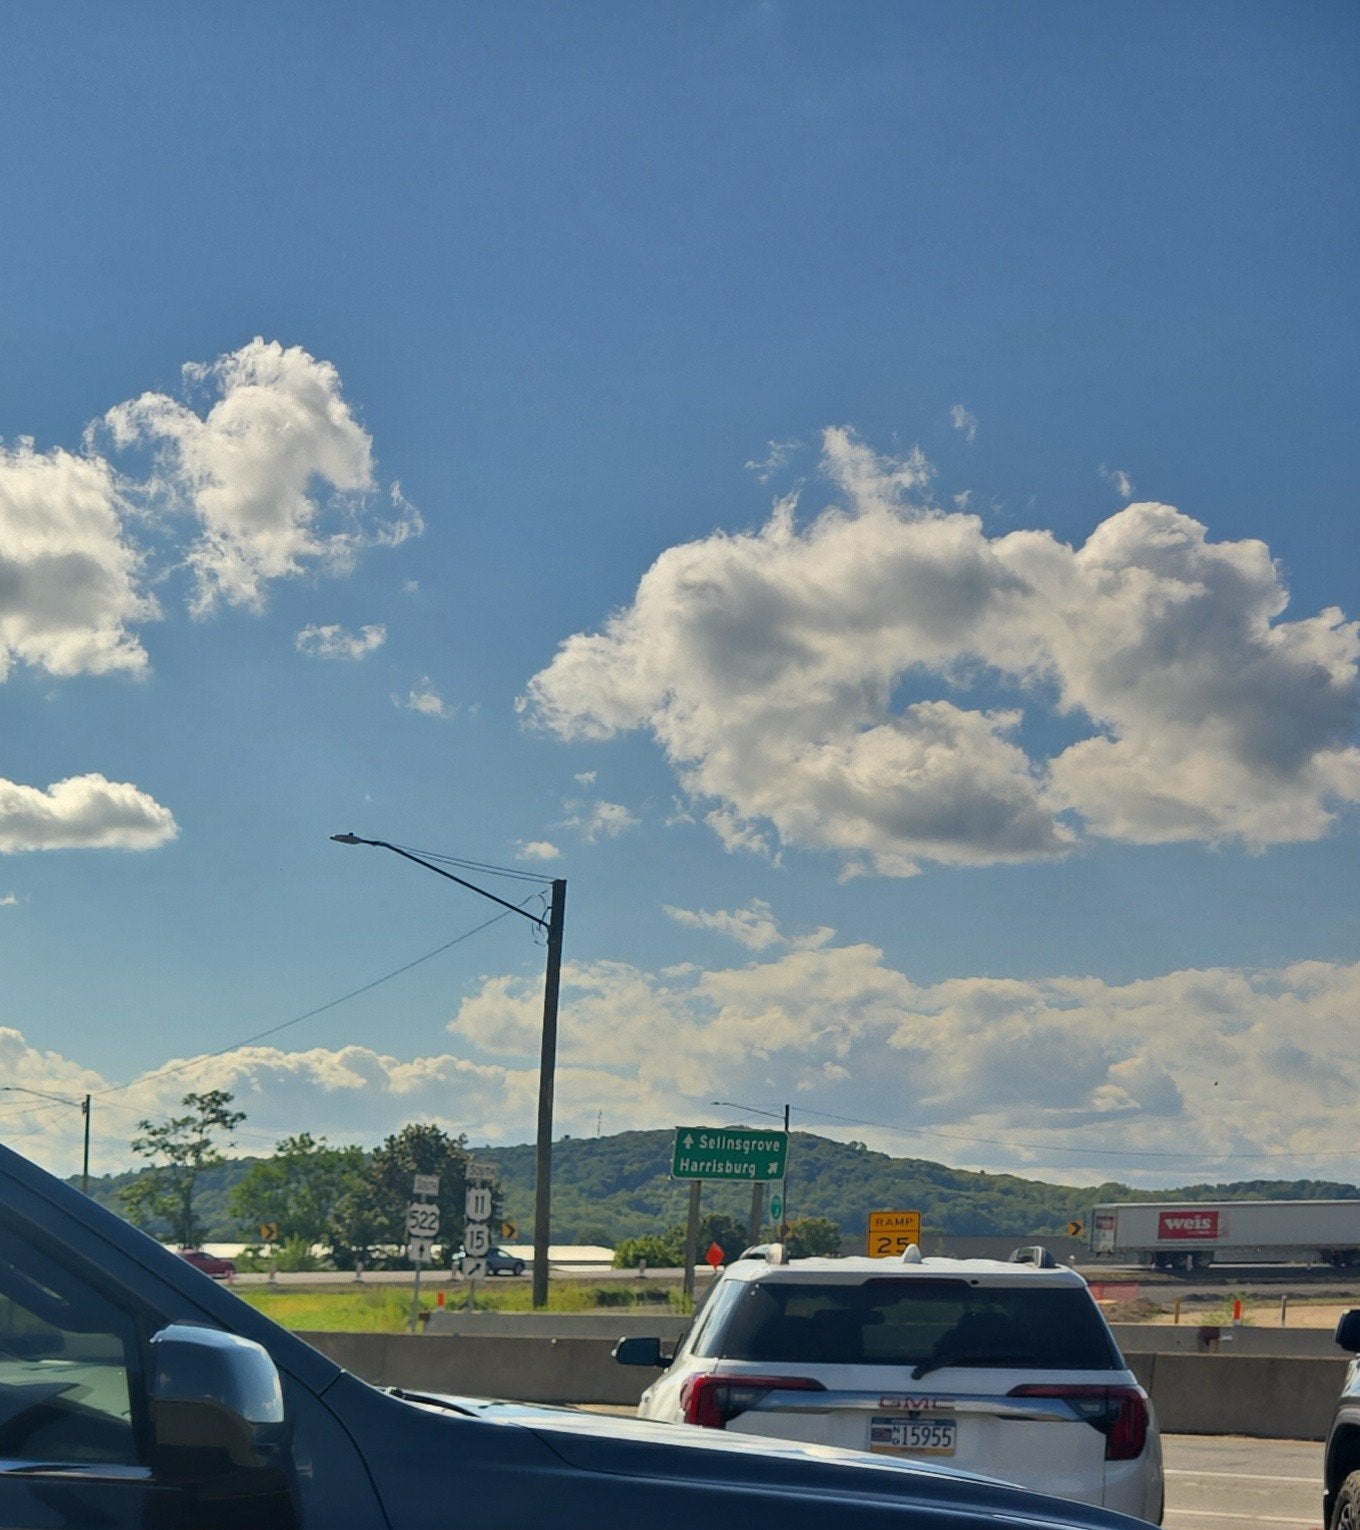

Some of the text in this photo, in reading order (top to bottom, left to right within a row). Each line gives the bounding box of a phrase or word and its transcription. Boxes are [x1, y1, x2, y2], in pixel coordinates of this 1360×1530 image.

[699, 1134, 780, 1155] Selinsgrove
[679, 1158, 756, 1177] Harrisburg
[473, 1195, 485, 1214] 11
[409, 1210, 438, 1231] 522
[875, 1217, 913, 1227] RAMP
[1164, 1214, 1212, 1231] weis
[469, 1230, 485, 1249] 15
[877, 1236, 909, 1255] 25
[878, 1397, 955, 1410] GMC
[902, 1426, 952, 1447] 15955
